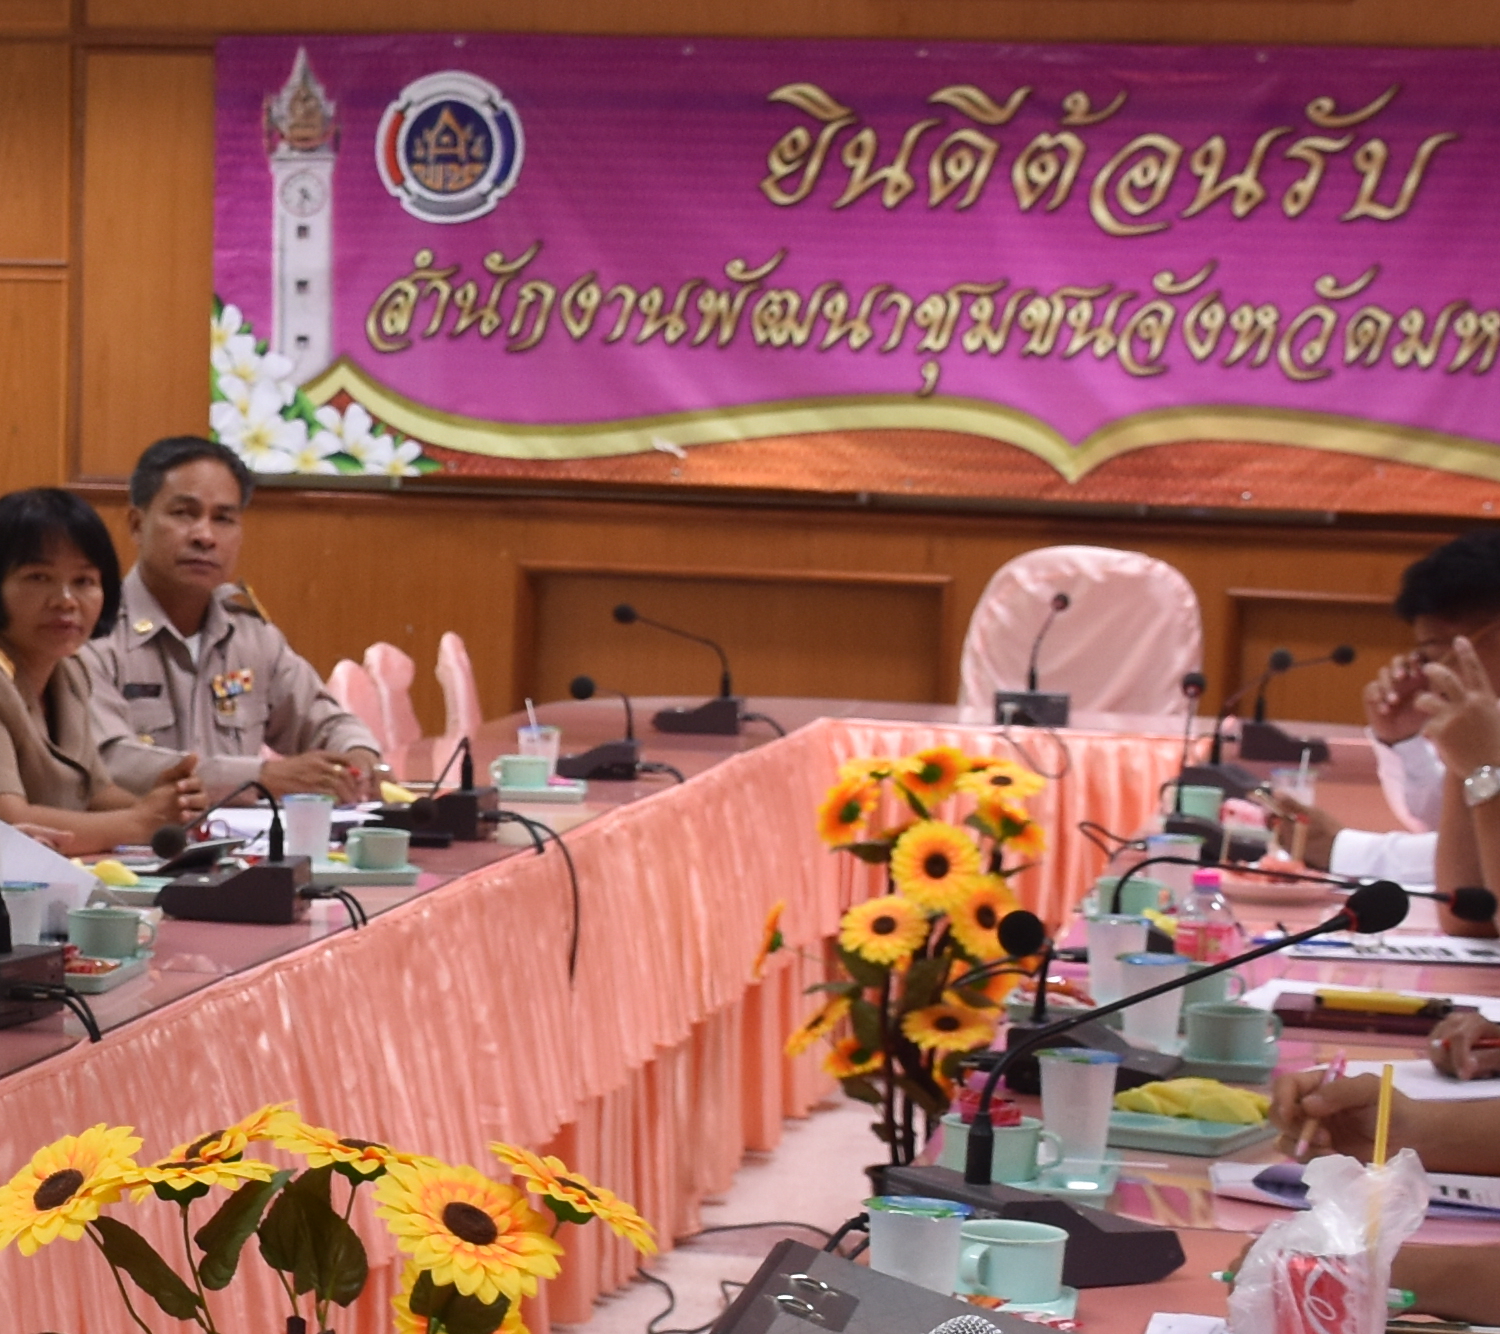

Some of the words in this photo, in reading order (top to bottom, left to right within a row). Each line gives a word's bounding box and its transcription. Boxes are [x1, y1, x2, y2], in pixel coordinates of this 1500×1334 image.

[760, 82, 1460, 237] ยินดีต้อนรับ
